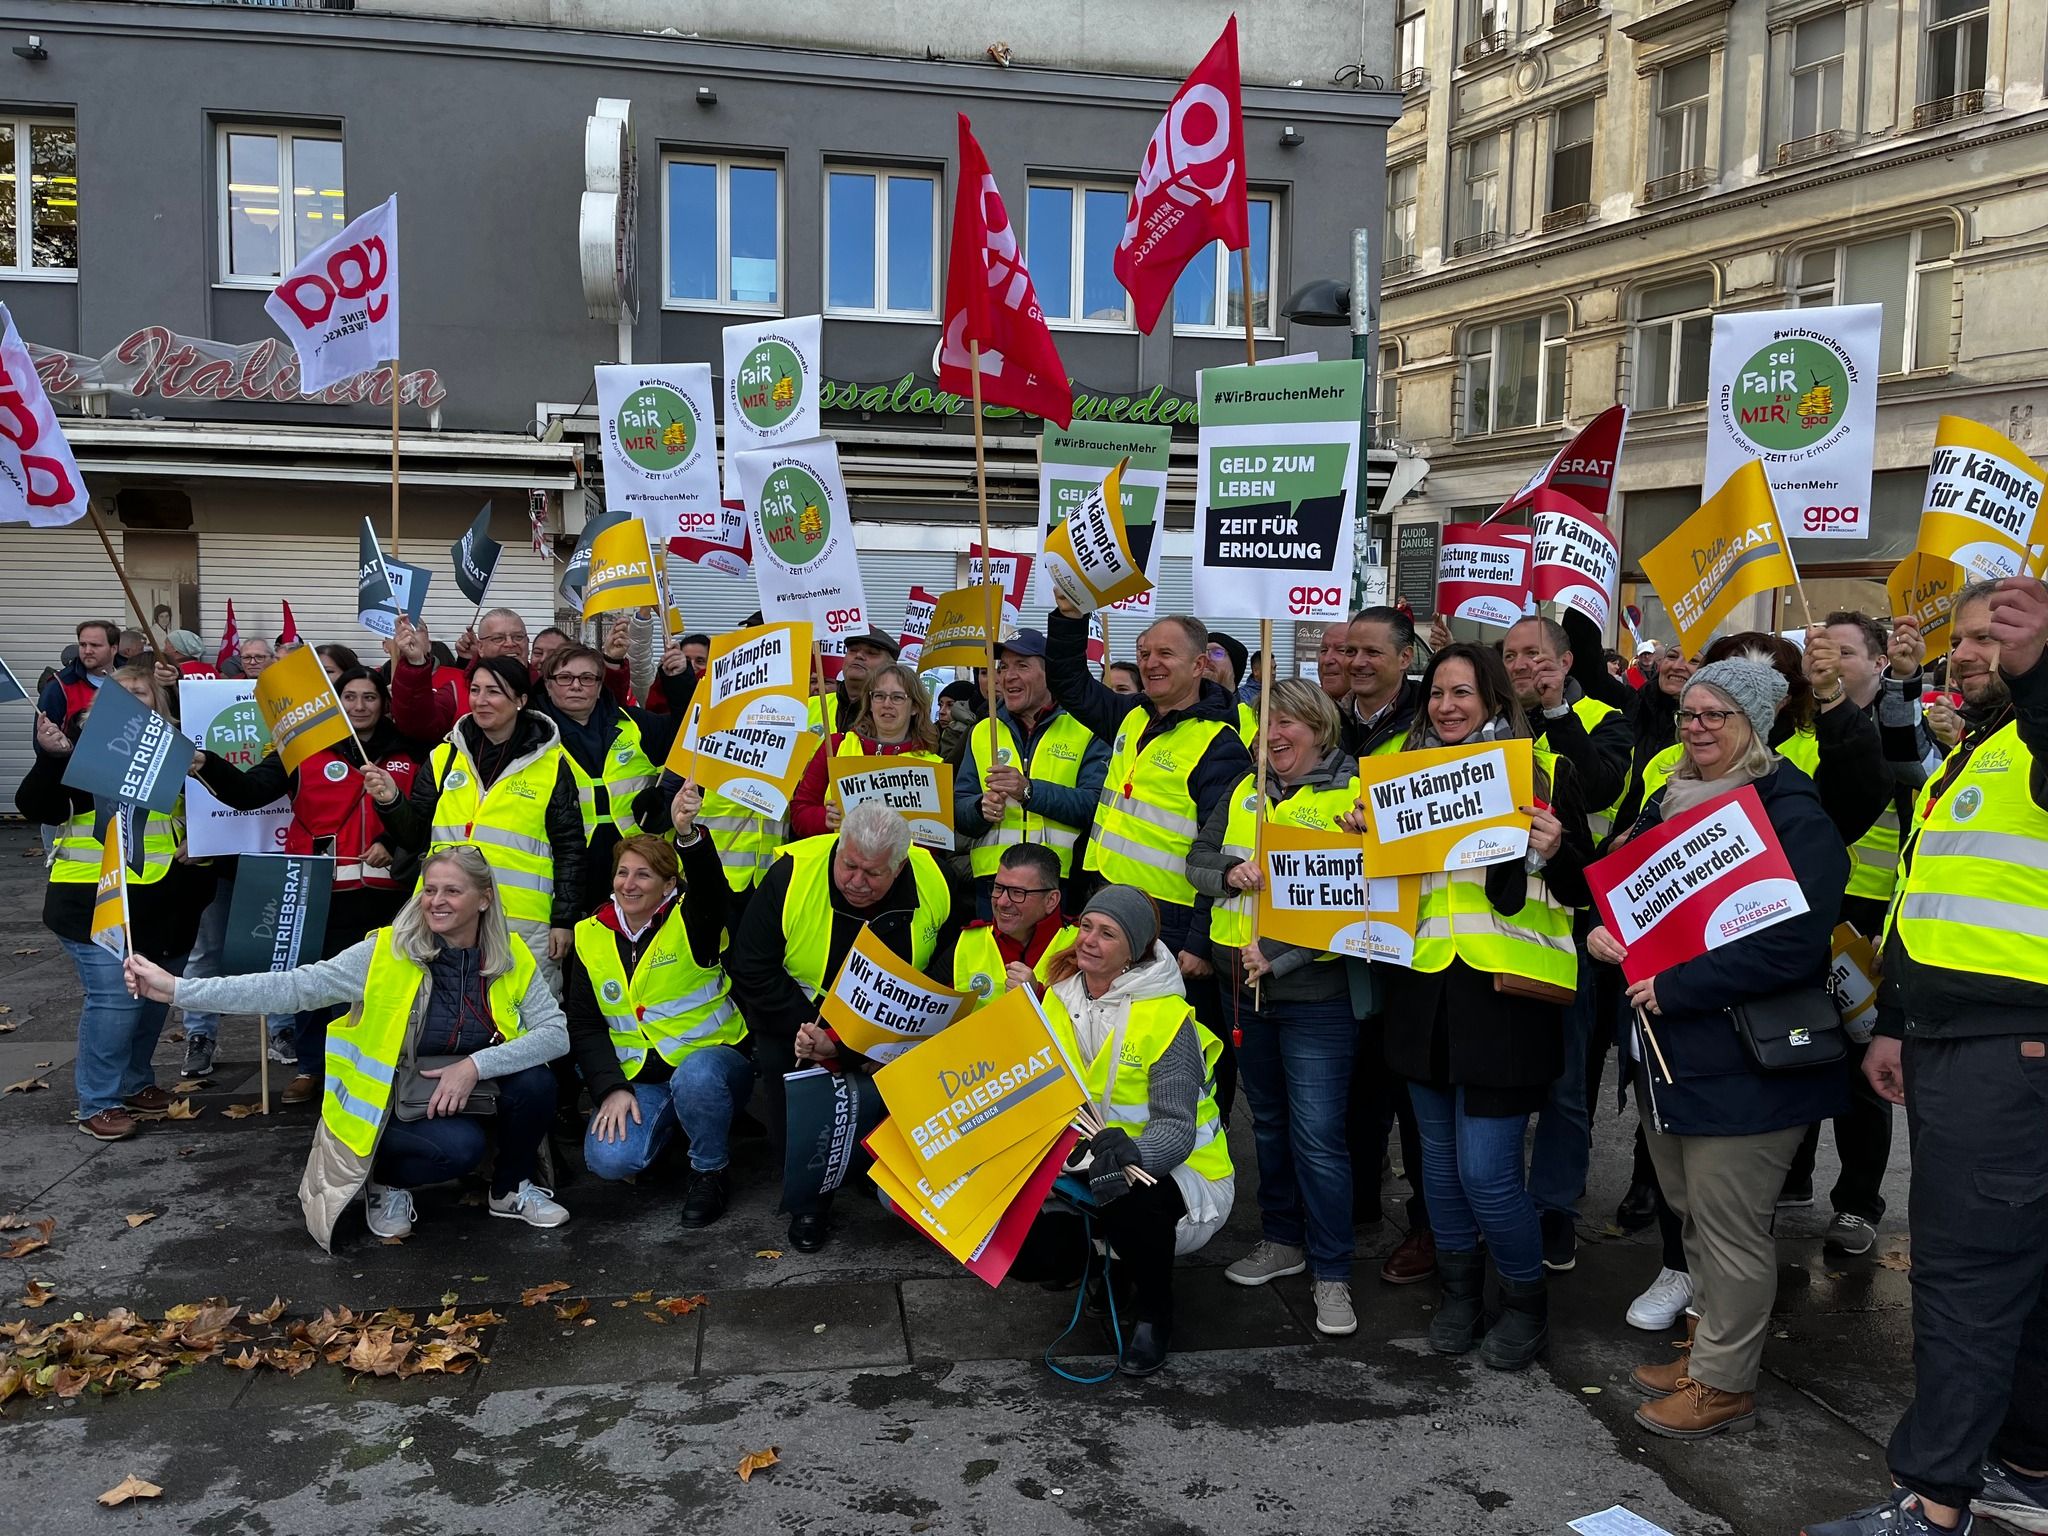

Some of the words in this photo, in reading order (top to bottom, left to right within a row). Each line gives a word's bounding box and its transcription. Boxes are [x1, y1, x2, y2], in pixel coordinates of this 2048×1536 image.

[755, 348, 770, 363] sei
[758, 334, 809, 375] #wirbrauchenmehr
[1769, 348, 1794, 366] sei
[1773, 327, 1858, 384] #wirbrauchenmehr
[741, 365, 772, 386] FaiR
[1742, 369, 1798, 395] FaiR
[638, 393, 656, 407] sei
[639, 378, 702, 422] #wirbrauchenmehr
[743, 393, 768, 409] MIR!
[774, 400, 791, 410] gpa
[1214, 386, 1345, 404] #WirBrauchenMehr
[1721, 384, 1730, 412] GELD
[1775, 394, 1791, 403] zu
[622, 409, 661, 428] FaiR
[732, 402, 740, 417] zum
[739, 416, 754, 435] Leben
[780, 406, 805, 433] Erholung
[1722, 414, 1734, 433] zum
[1740, 404, 1790, 425] MIR!
[1801, 415, 1828, 429] gpa
[608, 419, 617, 440] GELD
[612, 442, 622, 457] zum
[625, 436, 659, 450] MIR!
[667, 444, 685, 454] gpa
[1054, 437, 1157, 454] #WirBrauchenMehr
[1732, 432, 1756, 455] Leben
[1807, 425, 1851, 459] Erholung
[621, 456, 640, 475] Leben
[674, 452, 701, 478] Erholung
[1219, 457, 1267, 473] GELD
[1271, 455, 1315, 472] ZUM
[1764, 452, 1787, 463] ZEIT
[1789, 453, 1803, 462] für
[645, 472, 661, 480] ZEIT
[662, 472, 673, 480] für
[772, 457, 834, 502] #wirbrauchenmehr
[773, 475, 789, 493] sei
[1962, 453, 2039, 509] kämpfe
[625, 493, 699, 501] #WirBrauchenMehr
[1058, 488, 1088, 502] GEL
[1219, 480, 1275, 497] LEBEN
[762, 494, 797, 519] FaiR
[1930, 482, 1963, 508] für
[1964, 488, 2026, 536] Euch!
[679, 512, 715, 532] gpa
[785, 516, 794, 524] zu
[1220, 518, 1257, 535] ZEIT
[1261, 514, 1298, 535] FÜR
[1803, 506, 1859, 532] gpa
[768, 526, 797, 545] MIR!
[804, 531, 822, 545] gpa
[1088, 496, 1122, 574] kämpfen
[1402, 527, 1426, 538] AUDIO
[753, 511, 762, 535] GELD
[758, 535, 769, 552] zum
[767, 552, 785, 571] Leben
[789, 567, 803, 575] ZEIT
[803, 565, 814, 574] für
[814, 537, 838, 570] Erholung
[1070, 521, 1099, 572] Euch!
[1219, 542, 1321, 560] ERHOLUNG
[1401, 538, 1434, 548] DANUBE
[1556, 520, 1618, 573] kämpfen
[1481, 551, 1510, 564] muss
[1535, 541, 1559, 563] für
[1561, 544, 1607, 583] Euch!
[1691, 537, 1726, 576] Dein
[1468, 568, 1513, 581] werden!
[1672, 522, 1772, 620] BETRIEBSRAT
[776, 587, 841, 602] #WirBrauchenMehr
[1288, 586, 1342, 615] gpa
[825, 607, 861, 632] gpa
[942, 609, 965, 628] Dein
[1468, 607, 1511, 620] BETRIEBSRAT
[1679, 605, 1704, 633] BILLA
[925, 625, 986, 647] BETRIEBSRA
[714, 658, 730, 680] Wir
[731, 638, 781, 670] kämpfen
[720, 679, 733, 700] für
[735, 662, 768, 691] Euch!
[233, 708, 255, 722] sei
[747, 714, 795, 722] BETRIEBSRAT
[760, 704, 779, 714] Dein
[107, 714, 143, 756] Dein
[212, 724, 261, 743] FaiR
[698, 736, 722, 752] für
[724, 740, 768, 769] Euch!
[1060, 750, 1079, 758] DICH
[386, 760, 410, 771] gpa
[1162, 759, 1178, 769] DICH
[1990, 758, 2012, 768] DICH
[840, 776, 866, 796] Wir
[870, 769, 929, 791] kämpfen
[1374, 783, 1405, 810] Wir
[1410, 761, 1495, 798] kämpfen
[732, 787, 775, 811] BETRIEBSRAT
[884, 791, 922, 808] Euch!
[1289, 810, 1307, 821] FÜR
[1306, 816, 1328, 829] DICH
[1298, 804, 1319, 817] wir
[1396, 810, 1424, 835] für
[1427, 791, 1484, 827] Euch!
[1461, 845, 1516, 859] BETRIEBSRAT
[1478, 839, 1499, 849] Dein
[1271, 853, 1299, 877] Wir
[1305, 852, 1363, 878] kämpf
[1624, 849, 1686, 904] Leistung
[1683, 822, 1728, 857] muss
[1631, 879, 1684, 930] belohnt
[1682, 835, 1750, 889] werden!
[1287, 884, 1313, 906] für
[270, 859, 301, 972] BETRIEBSRAT
[1719, 898, 1788, 932] BETRIEBSRAT
[1735, 899, 1761, 915] Dein
[252, 898, 277, 939] Dein
[850, 951, 873, 984] Wir
[873, 972, 949, 1015] kämpfen
[850, 986, 873, 1014] für
[874, 1002, 926, 1033] Euch!
[937, 1057, 995, 1099] Dein
[910, 1046, 1055, 1147] BETRIEBSRAT
[819, 1076, 848, 1194] BETRIEBSRAT
[920, 1128, 961, 1161] BILLA
[960, 1122, 972, 1133] WIR
[972, 1114, 985, 1126] FÜR
[985, 1106, 999, 1118] DICH
